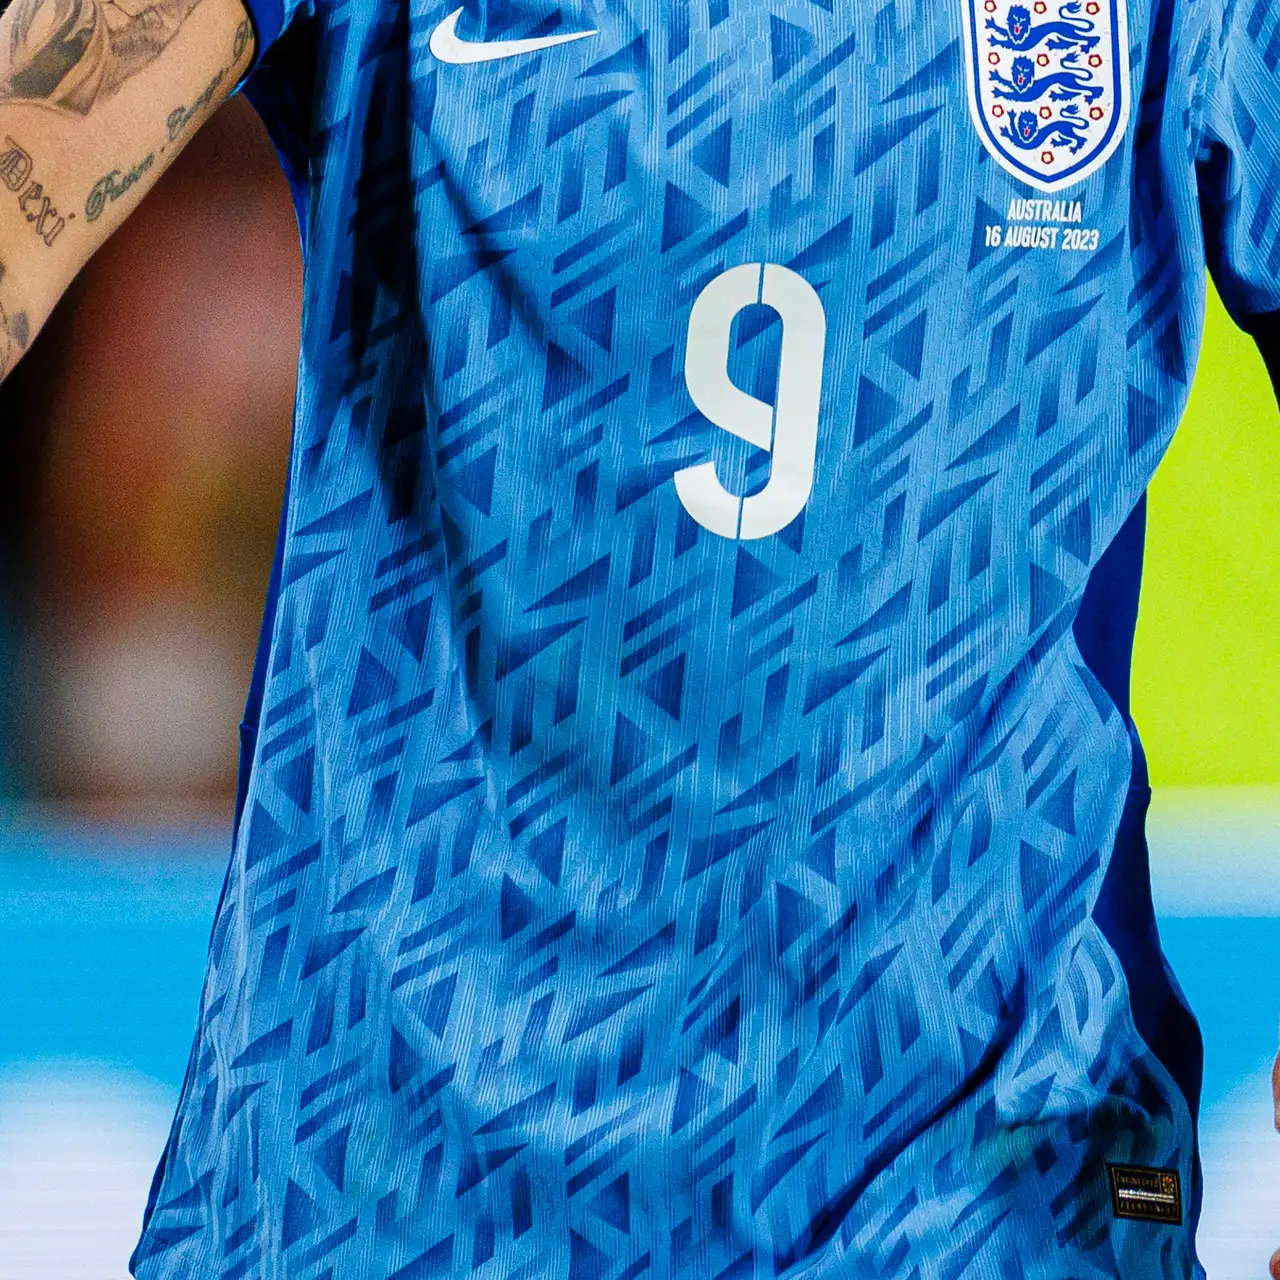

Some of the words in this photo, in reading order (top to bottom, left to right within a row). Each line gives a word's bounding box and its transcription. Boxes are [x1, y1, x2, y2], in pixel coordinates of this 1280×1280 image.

[1006, 198, 1082, 223] AUSTRALIA
[984, 224, 1002, 248] 16
[1004, 225, 1060, 249] AUGUST
[1061, 227, 1100, 251] 2023
[673, 262, 826, 540] 9
